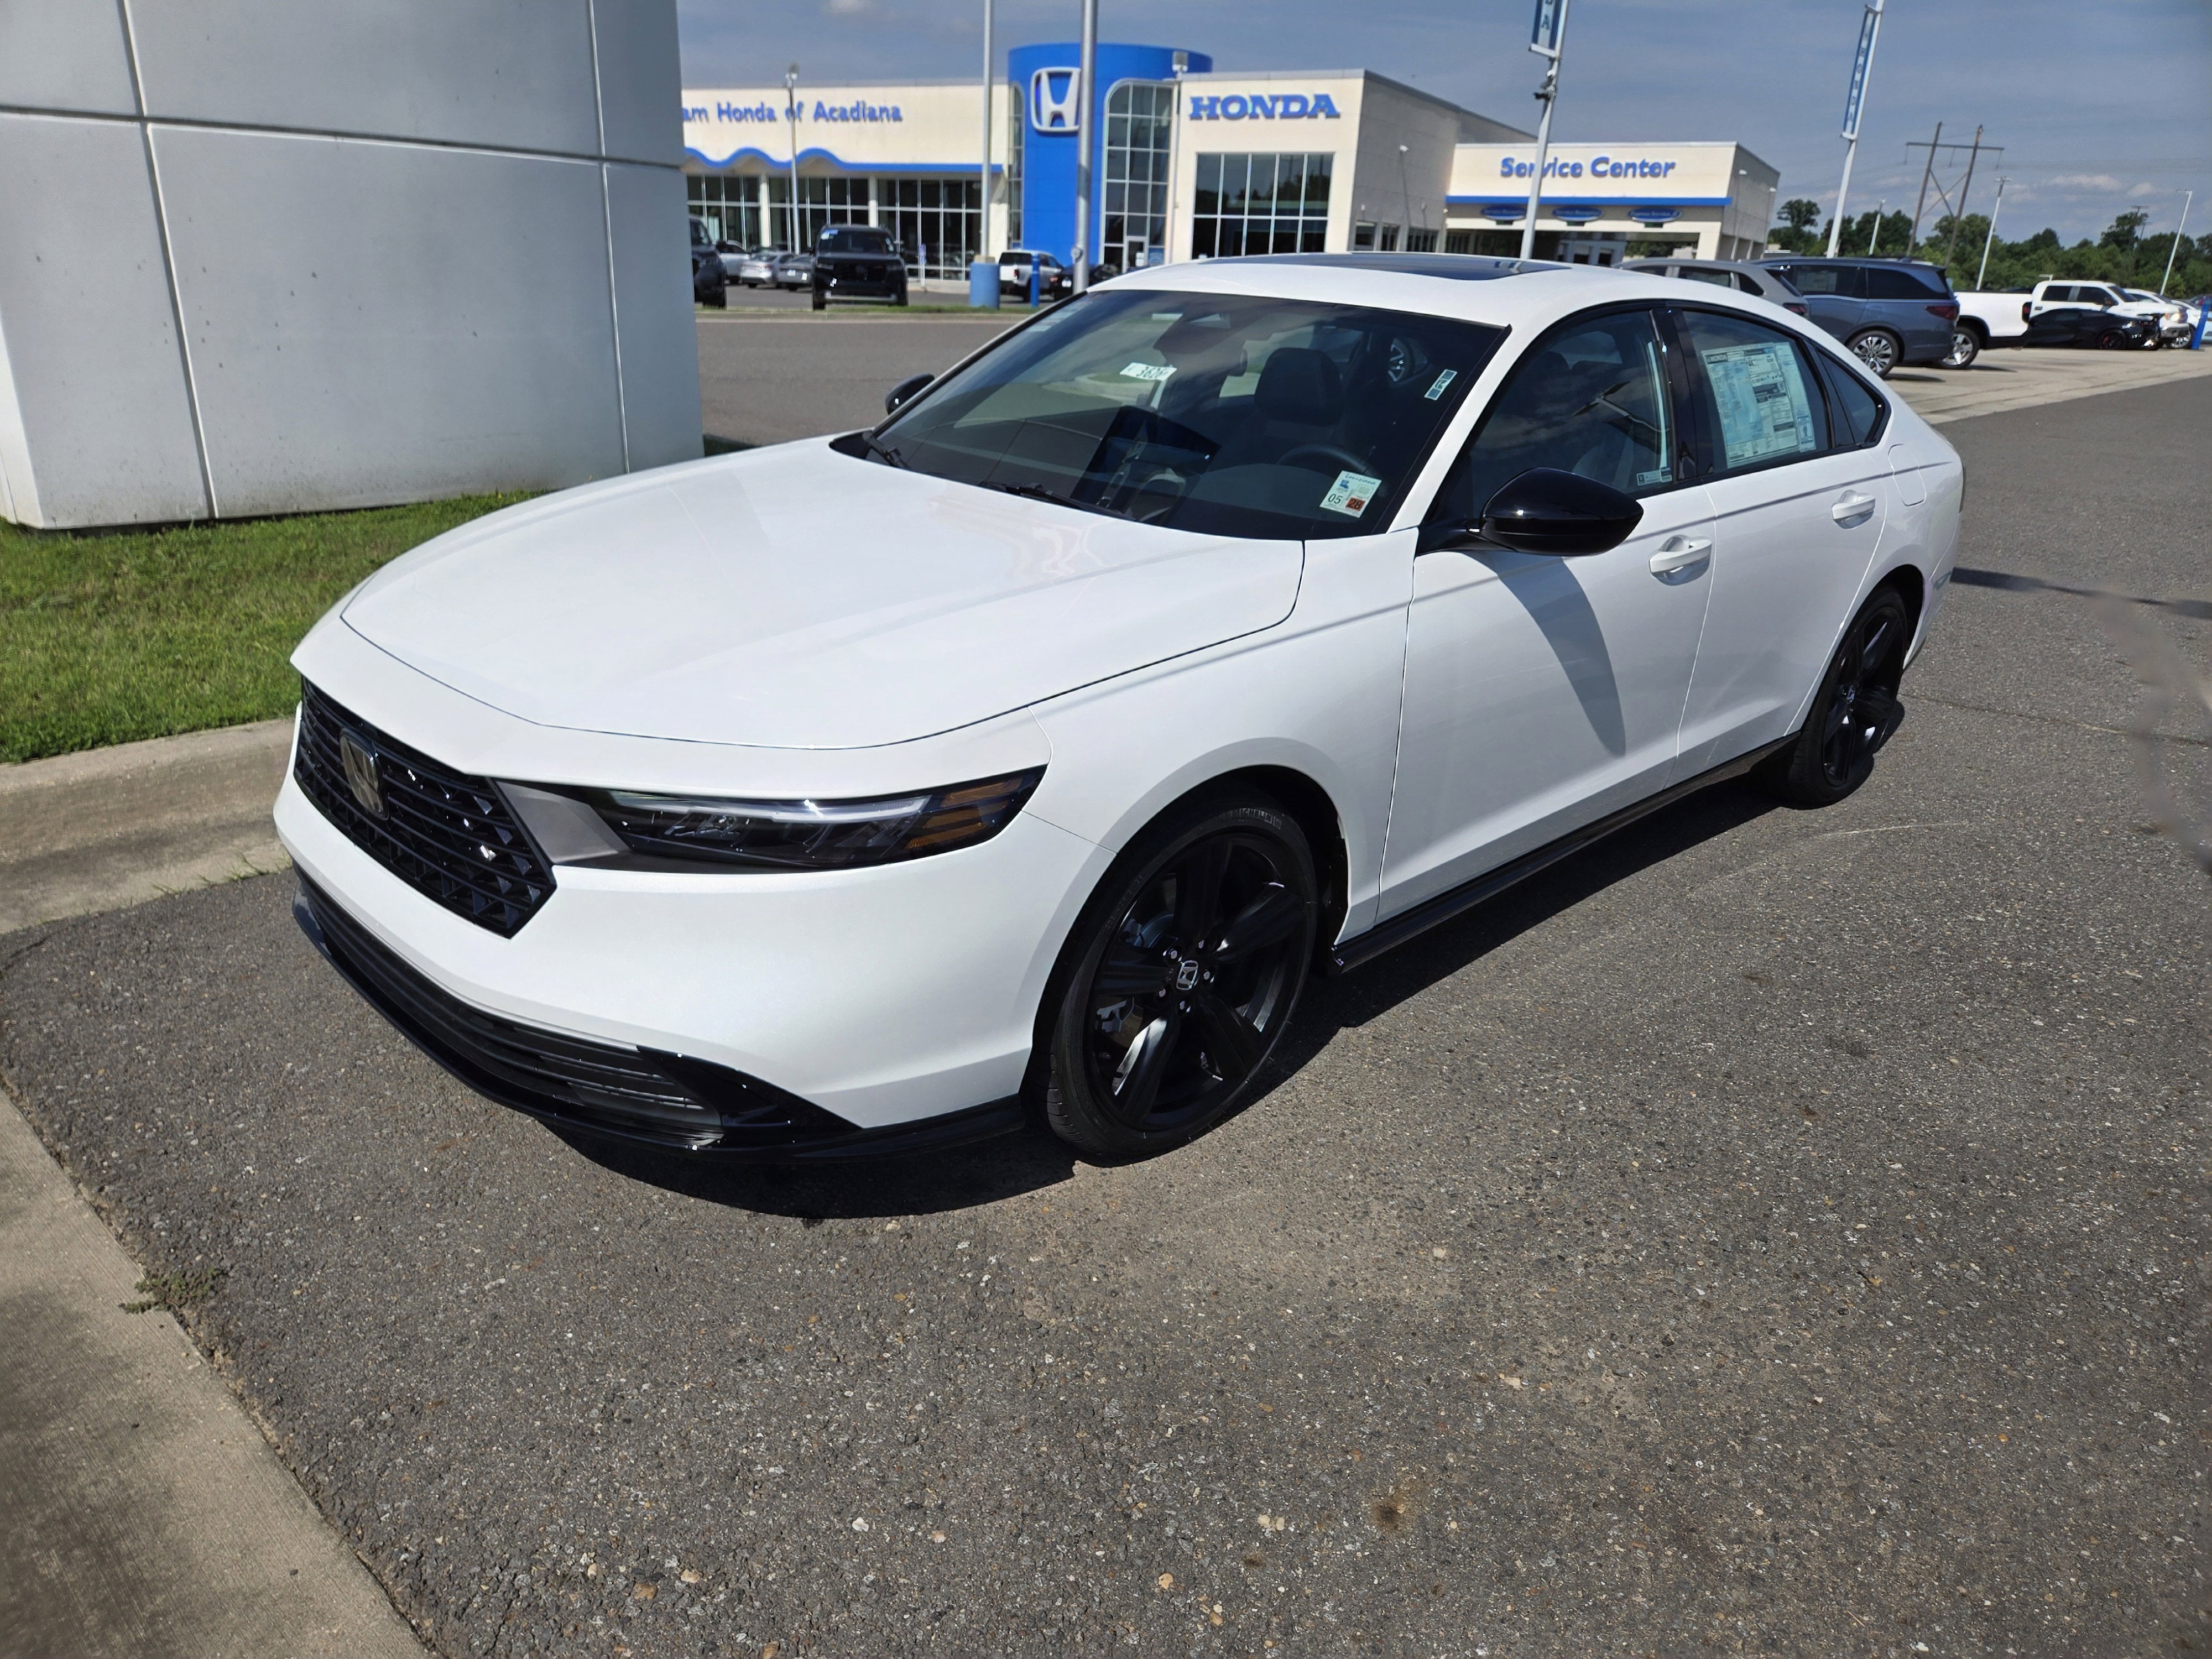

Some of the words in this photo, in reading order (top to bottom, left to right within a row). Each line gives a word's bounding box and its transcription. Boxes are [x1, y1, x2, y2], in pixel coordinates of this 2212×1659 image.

[717, 101, 777, 123] Honda
[814, 101, 902, 123] Acadiana
[1190, 93, 1340, 121] HONDA
[1500, 157, 1583, 178] Service
[1590, 156, 1676, 178] Center
[1345, 473, 1376, 485] Louisiana
[1328, 494, 1343, 504] 05
[1348, 499, 1363, 509] 28
